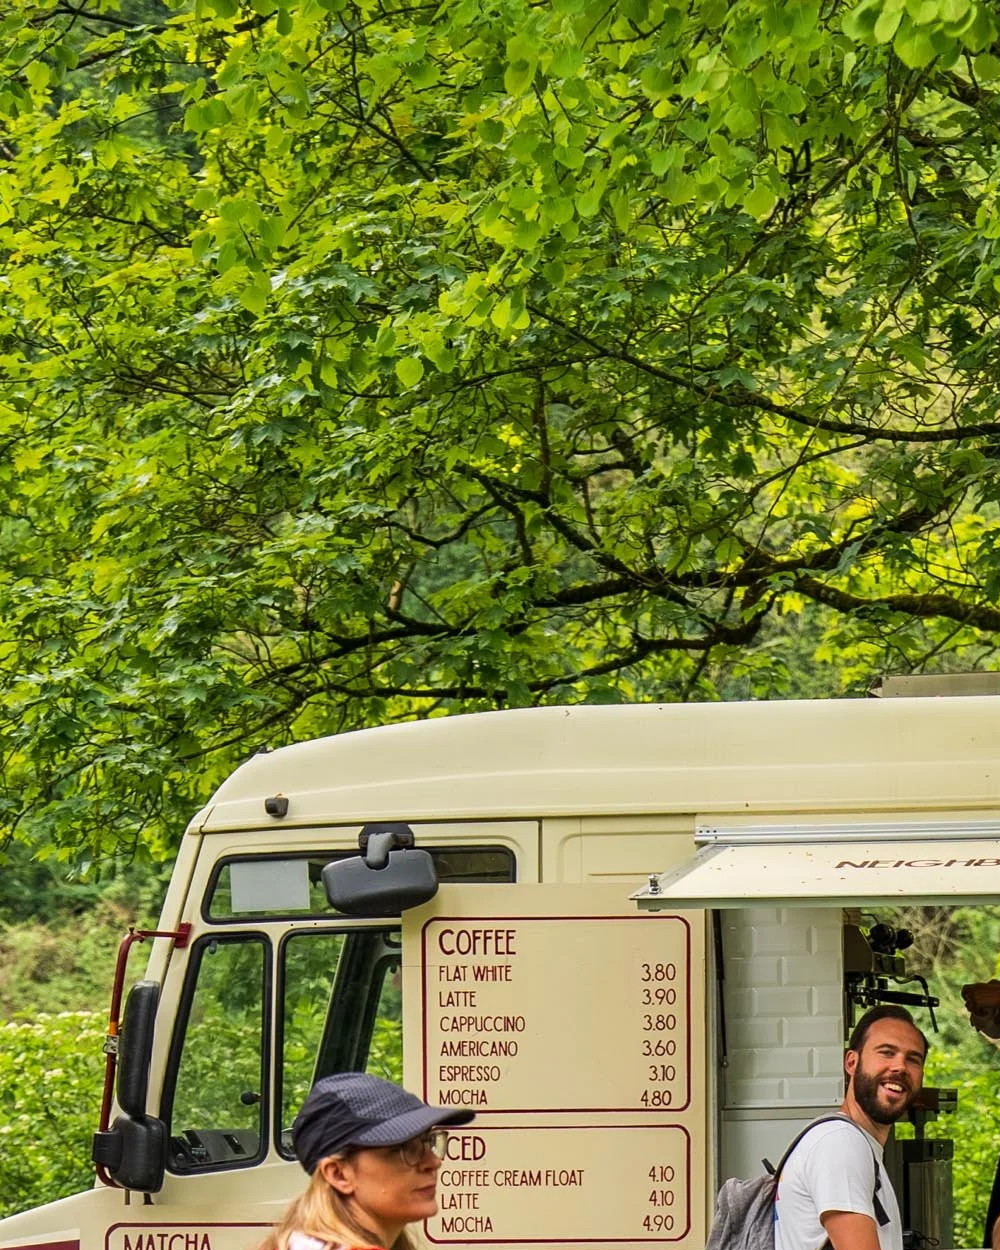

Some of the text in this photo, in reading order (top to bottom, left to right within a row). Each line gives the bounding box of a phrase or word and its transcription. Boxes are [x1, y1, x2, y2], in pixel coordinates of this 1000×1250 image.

[439, 929, 516, 955] COFFEE
[440, 964, 676, 981] FLAT WHITE 3.80
[439, 989, 676, 1007] LATTE 3.90
[440, 1014, 676, 1032] CAPPUCCINO 3.80
[441, 1040, 676, 1056] AMERICANO 3.60
[440, 1065, 675, 1081] ESPRESSO 3.10
[440, 1090, 671, 1107] MOCHA 4.80
[442, 1136, 486, 1161] CED
[441, 1166, 674, 1186] COFFEE CREAM FLOAT 4.10
[442, 1190, 674, 1209] LATTE 4.10
[442, 1215, 674, 1232] MOCHA 4.90
